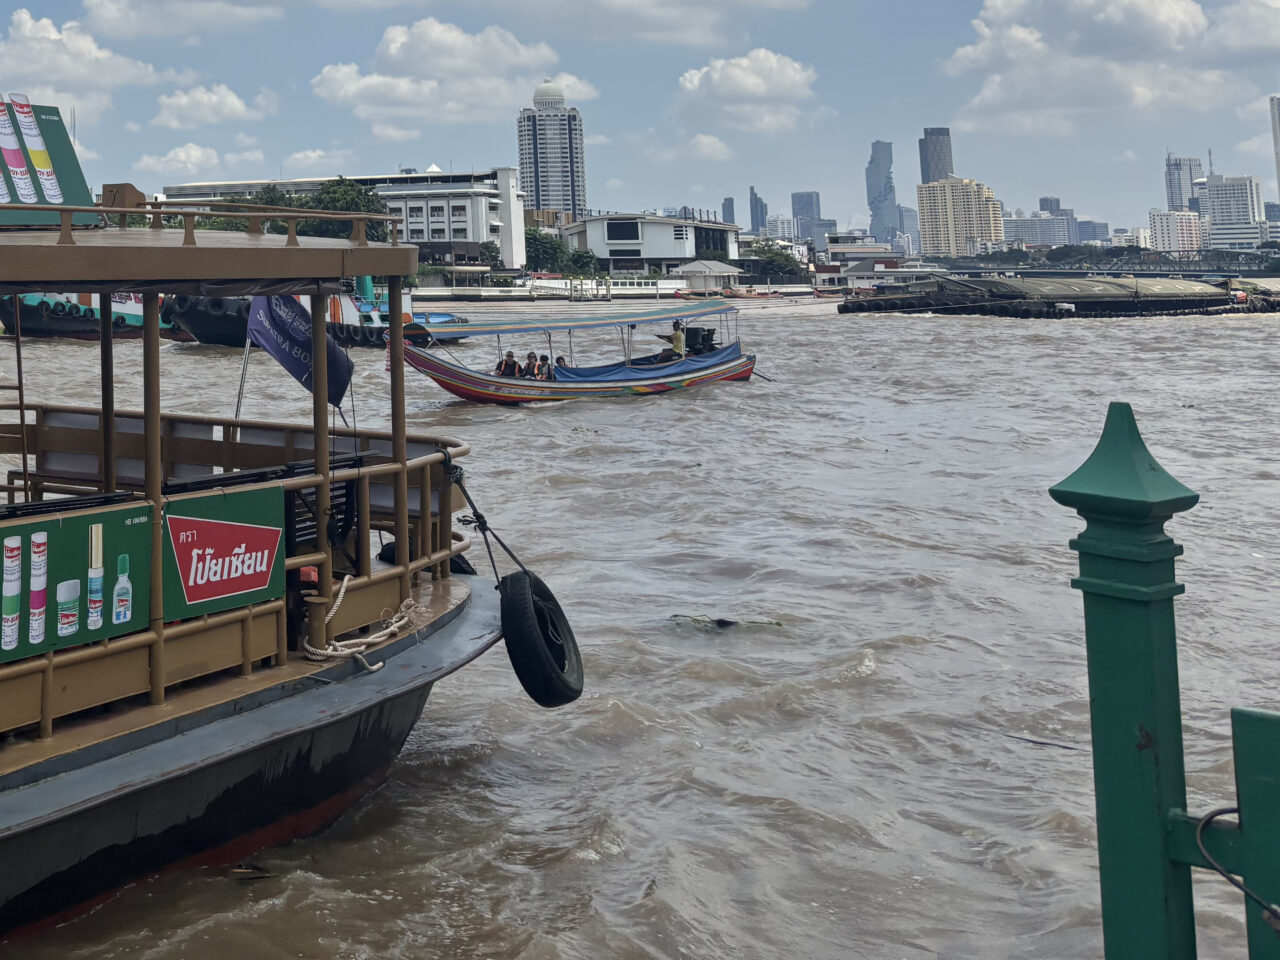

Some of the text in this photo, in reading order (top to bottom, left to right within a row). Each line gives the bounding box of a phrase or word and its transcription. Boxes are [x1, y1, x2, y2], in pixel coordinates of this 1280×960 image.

[179, 530, 197, 544] ตรา
[188, 543, 269, 587] โป๊ยเซียน
